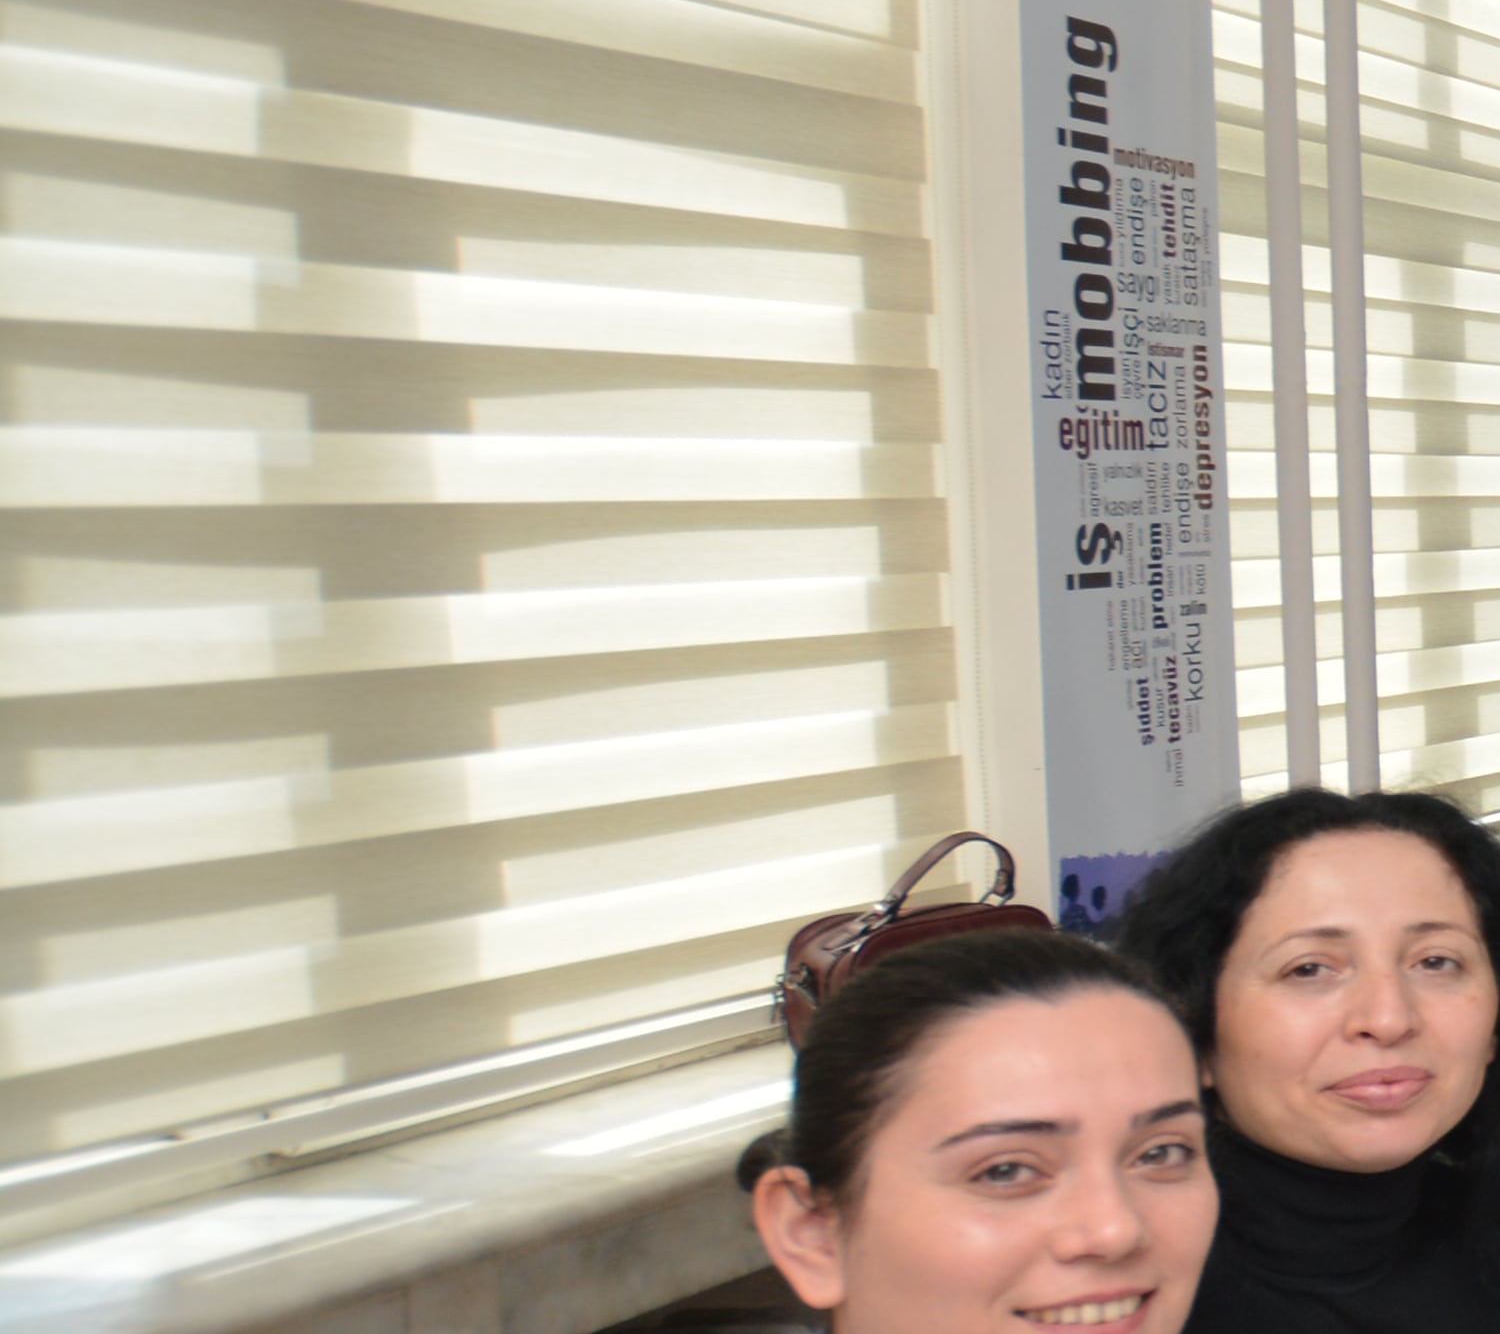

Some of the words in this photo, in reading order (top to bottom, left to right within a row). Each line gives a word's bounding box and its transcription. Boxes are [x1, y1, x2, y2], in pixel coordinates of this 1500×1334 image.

[1056, 15, 1118, 401] mobbing
[1126, 177, 1148, 265] endişe
[1160, 183, 1177, 259] tehdit
[1180, 187, 1201, 307] sataşma
[1039, 309, 1064, 400] kadın
[1117, 307, 1145, 356] işçi
[1058, 404, 1145, 461] eğitim
[1143, 360, 1169, 450] taciz
[1172, 366, 1188, 449] zorlama
[1191, 344, 1217, 511] depresyon
[1175, 461, 1194, 544] endişe
[1065, 523, 1124, 591] iş
[1147, 522, 1169, 630] problem
[1162, 655, 1182, 744] tecavüz
[1181, 622, 1204, 702] korku
[1135, 676, 1155, 746] şiddet
